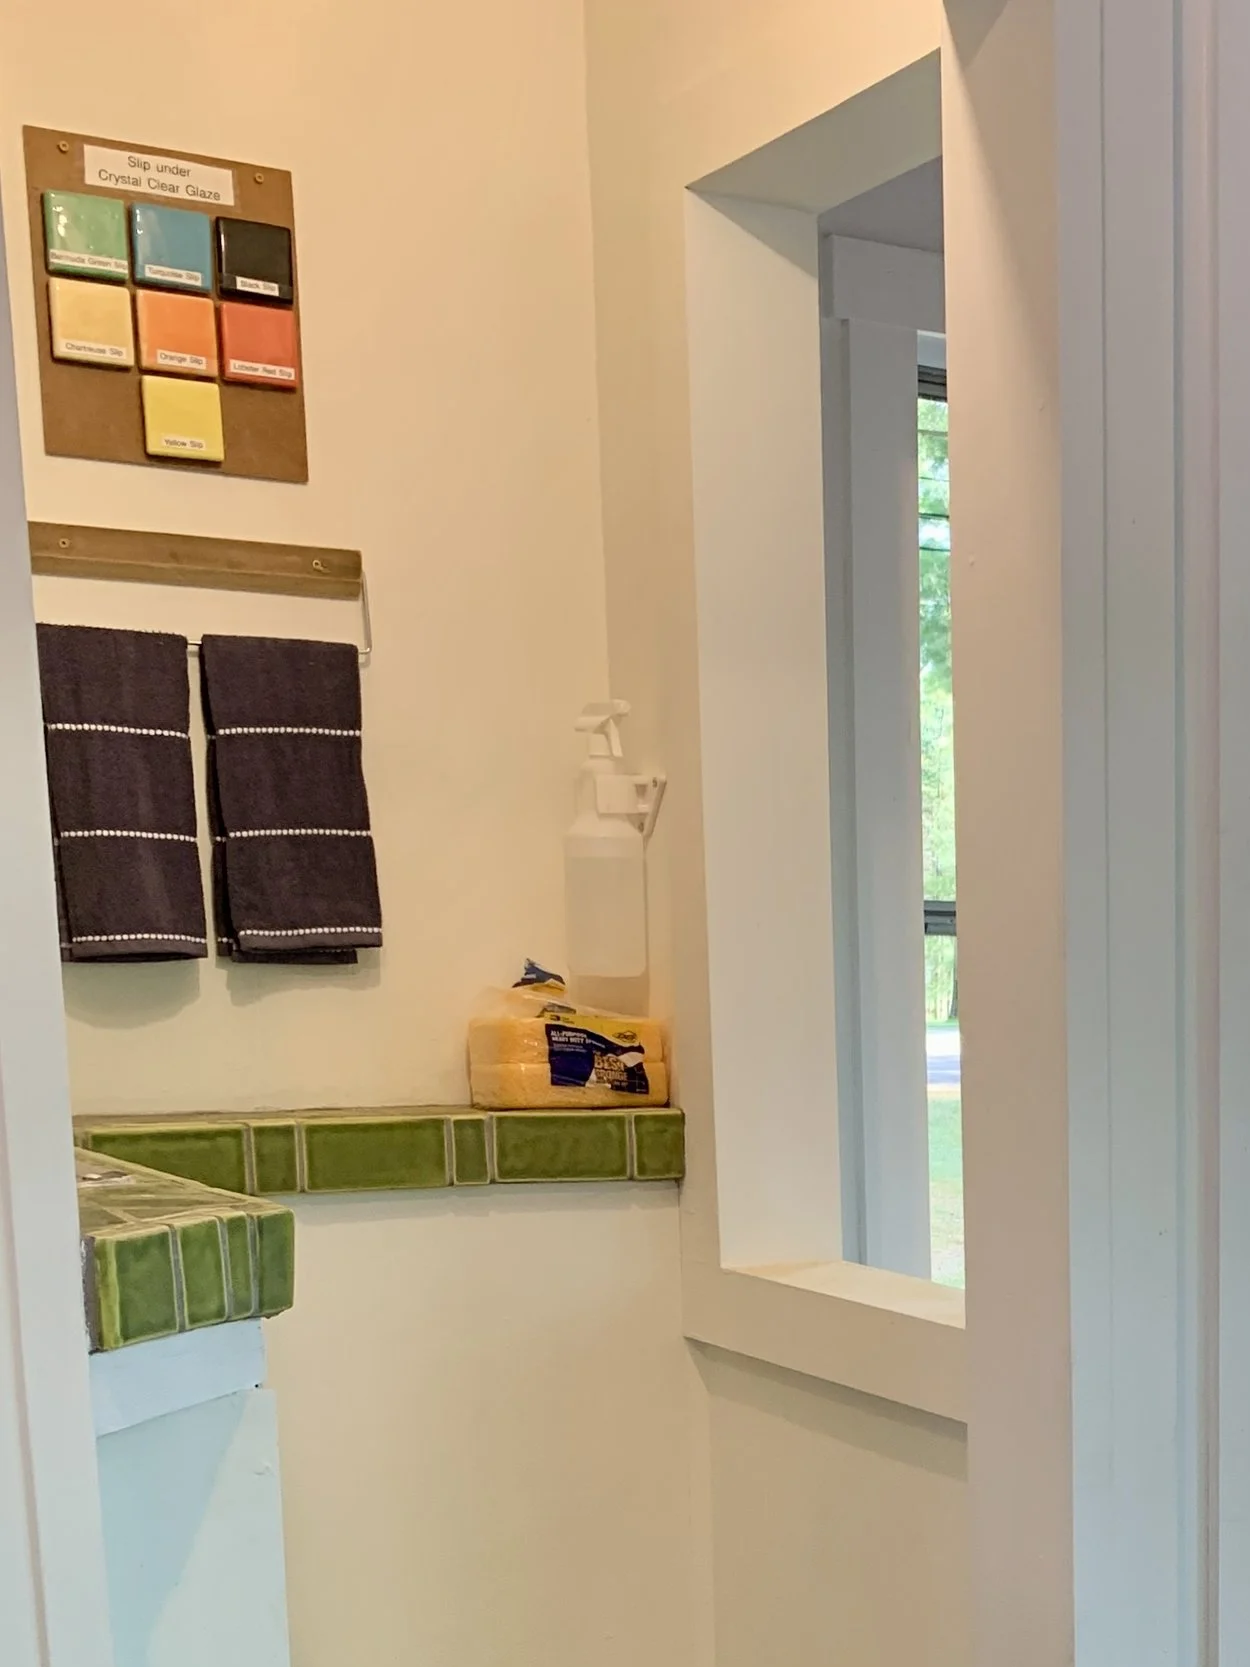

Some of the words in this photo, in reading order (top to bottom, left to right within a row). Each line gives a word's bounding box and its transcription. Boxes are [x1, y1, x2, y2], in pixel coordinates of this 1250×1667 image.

[127, 155, 150, 171] Slip
[156, 162, 191, 178] under
[98, 168, 142, 187] Crystal
[147, 177, 180, 194] Clear
[185, 184, 221, 201] Glaze
[240, 279, 260, 290] Black
[262, 283, 276, 292] Slip
[65, 341, 107, 355] Chartreuse
[109, 346, 124, 357] Slip
[159, 352, 188, 365] Orange
[189, 355, 204, 366] Slip
[278, 368, 293, 379] Slip
[164, 438, 187, 447] Yellow
[189, 440, 204, 449] Slip
